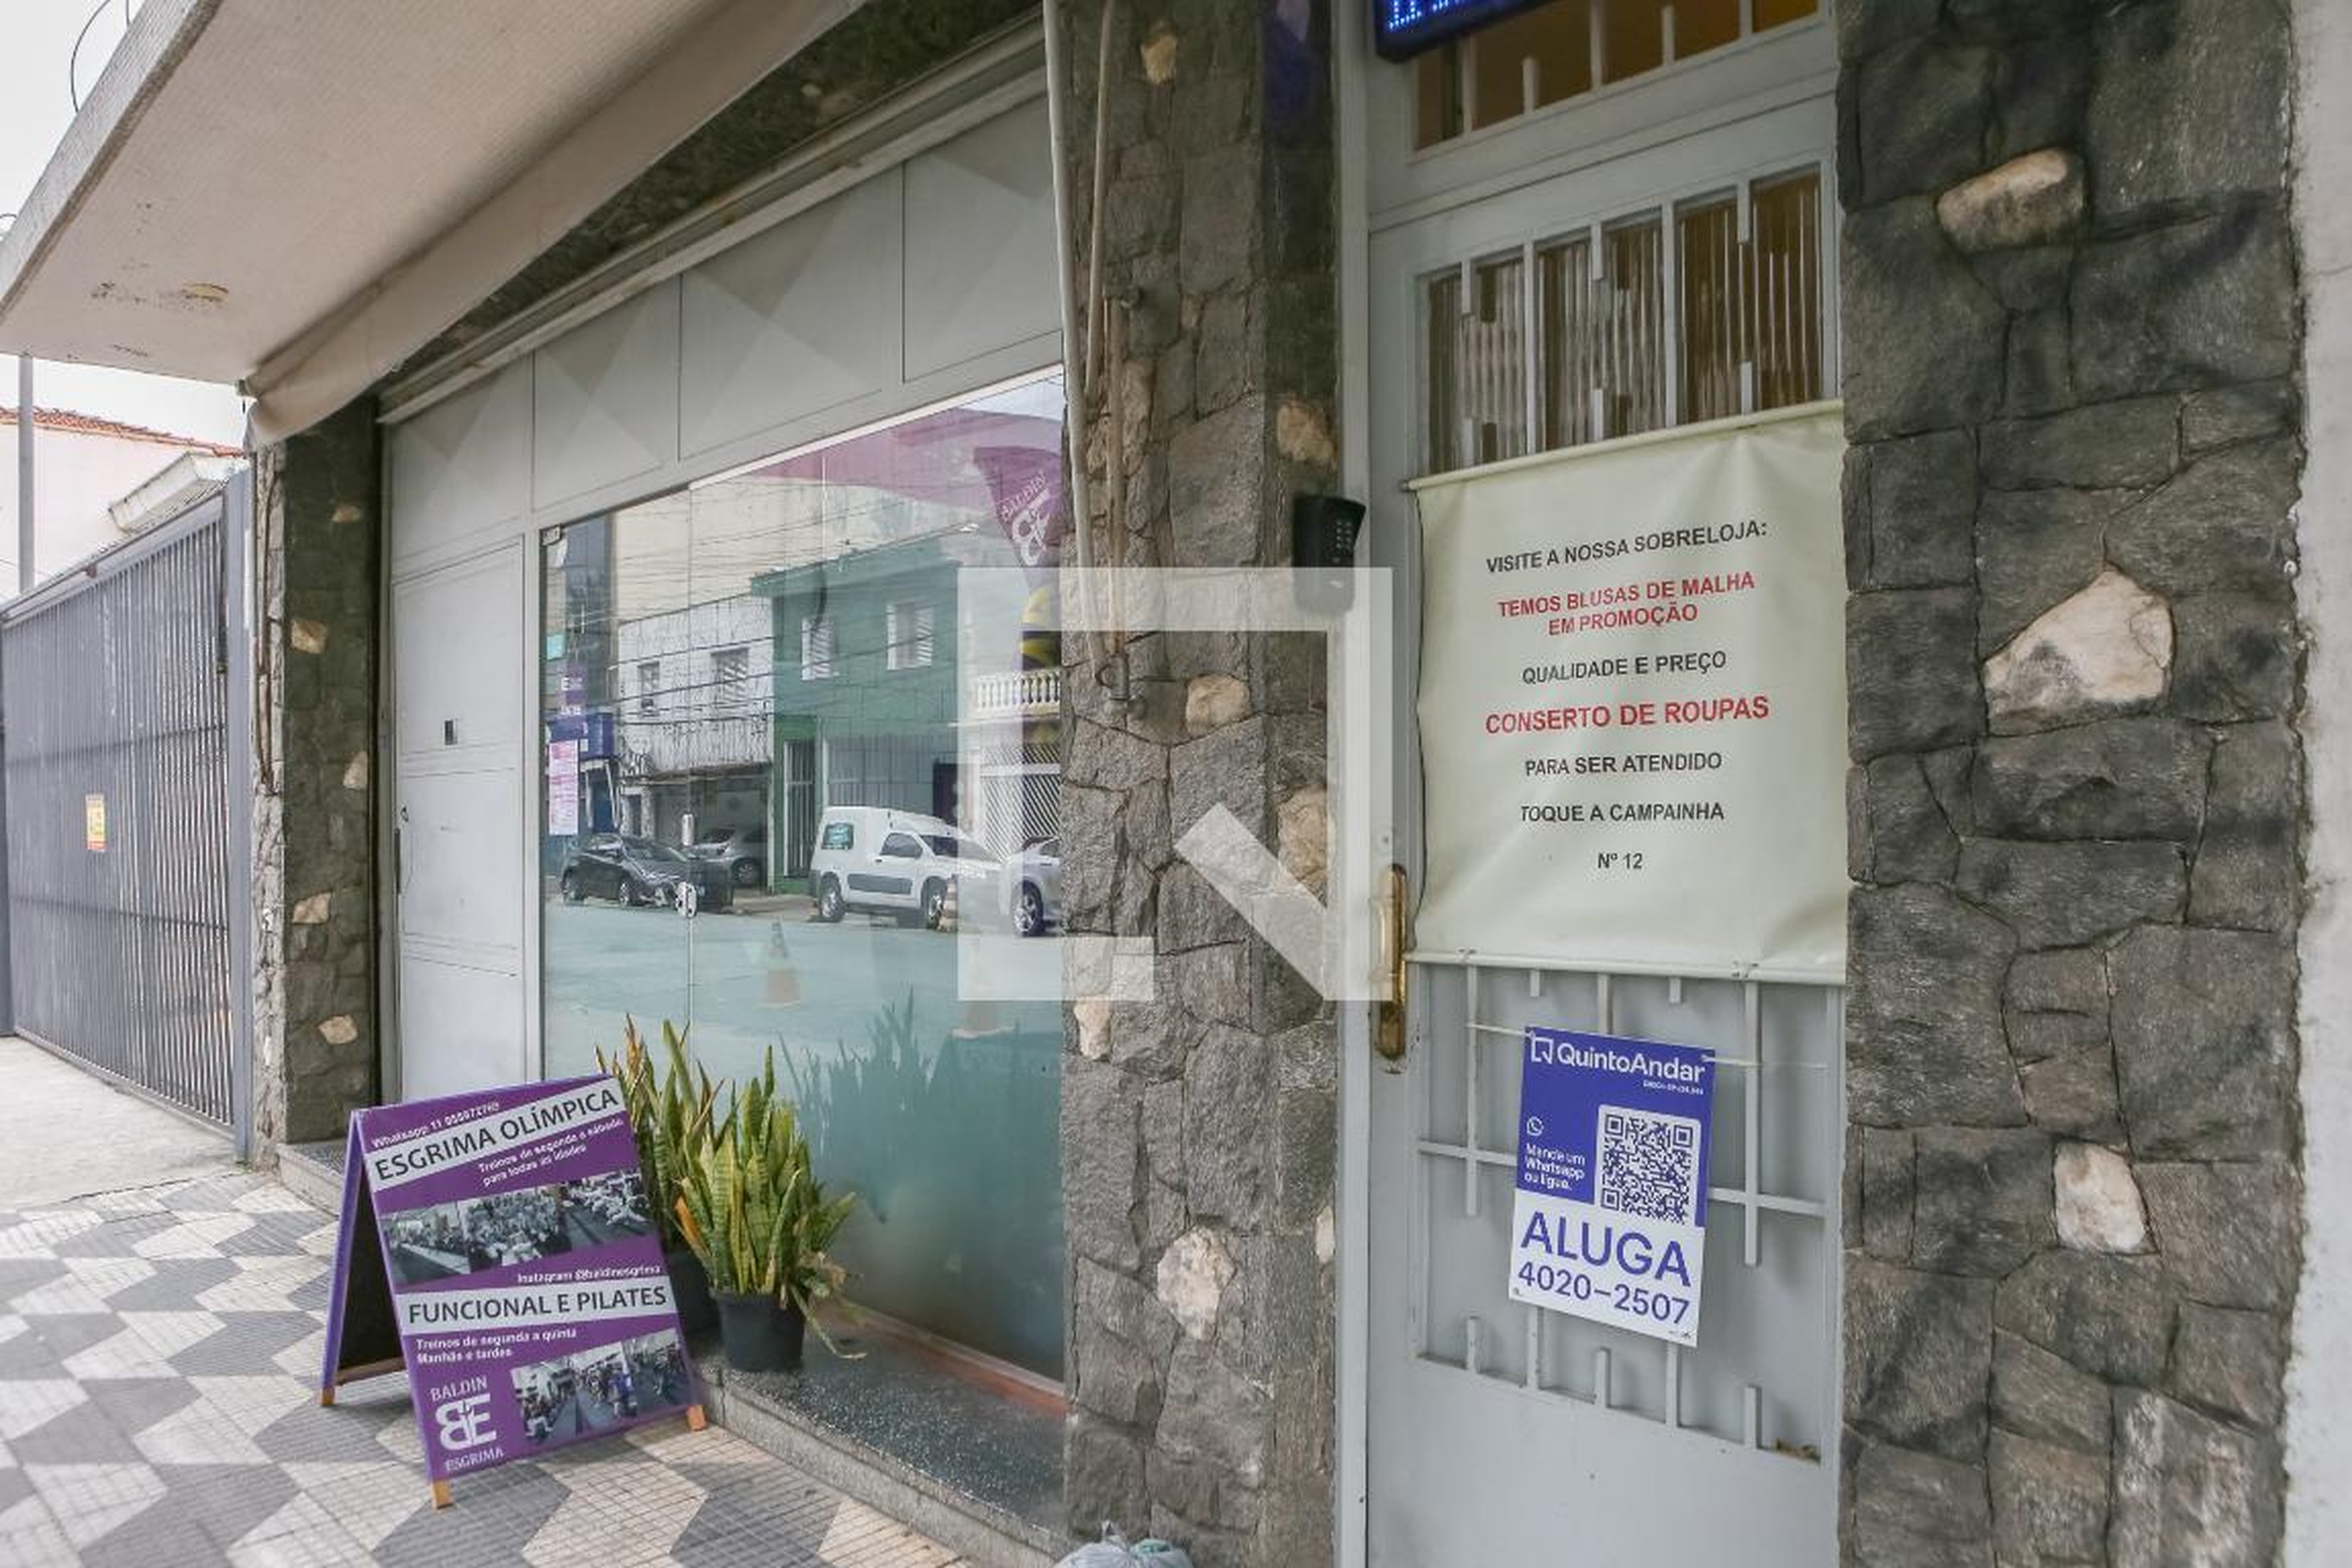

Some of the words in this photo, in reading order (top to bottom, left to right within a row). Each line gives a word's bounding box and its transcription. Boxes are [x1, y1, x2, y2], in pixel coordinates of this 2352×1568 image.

[1486, 551, 1542, 573] VISITE
[1547, 549, 1560, 566] A
[1565, 539, 1629, 565] NOSSA
[1634, 520, 1768, 552] SOBRELOJA:
[1499, 595, 1561, 617] TEMOS
[1567, 585, 1640, 609] BLUSAS
[1647, 581, 1675, 599] DE
[1683, 571, 1755, 596] MALHA
[1549, 619, 1575, 636] EM
[1580, 601, 1698, 631] PROMOÇÃO
[1523, 658, 1628, 685] QUALIDADE
[1635, 657, 1649, 674] E
[1656, 650, 1727, 674] PREÇO
[1486, 706, 1610, 734] CONSERTO
[1621, 703, 1656, 726] DE
[1665, 696, 1770, 724] ROUPAS
[1525, 759, 1570, 777] PARA
[1575, 756, 1616, 775] SER
[1623, 752, 1722, 772] ATENDIDO
[1521, 805, 1584, 823] TOQUE
[1590, 805, 1604, 821] A
[1610, 802, 1724, 821] CAMPAINHA
[1623, 853, 1643, 870] 12
[1557, 1042, 1706, 1082] QuintoAndar
[375, 1129, 497, 1181] ESGRIMA
[500, 1089, 619, 1140] OLÍMPICA
[483, 1171, 507, 1187] para
[508, 1161, 537, 1177] todas
[1520, 1210, 1692, 1287] ALUGA
[409, 1295, 552, 1324] FUNCIONAL
[557, 1294, 570, 1313] E
[578, 1286, 667, 1313] PILATES
[1518, 1261, 1691, 1325] 4020-2507
[416, 1338, 460, 1351] Treinos
[463, 1336, 478, 1347] de
[480, 1331, 530, 1346] segunda
[532, 1332, 540, 1341] a
[542, 1328, 577, 1341] quinta
[466, 1351, 474, 1360] e
[476, 1347, 513, 1360] tardes
[430, 1375, 488, 1401] BALDIN
[445, 1447, 504, 1472] ESGRIMA
